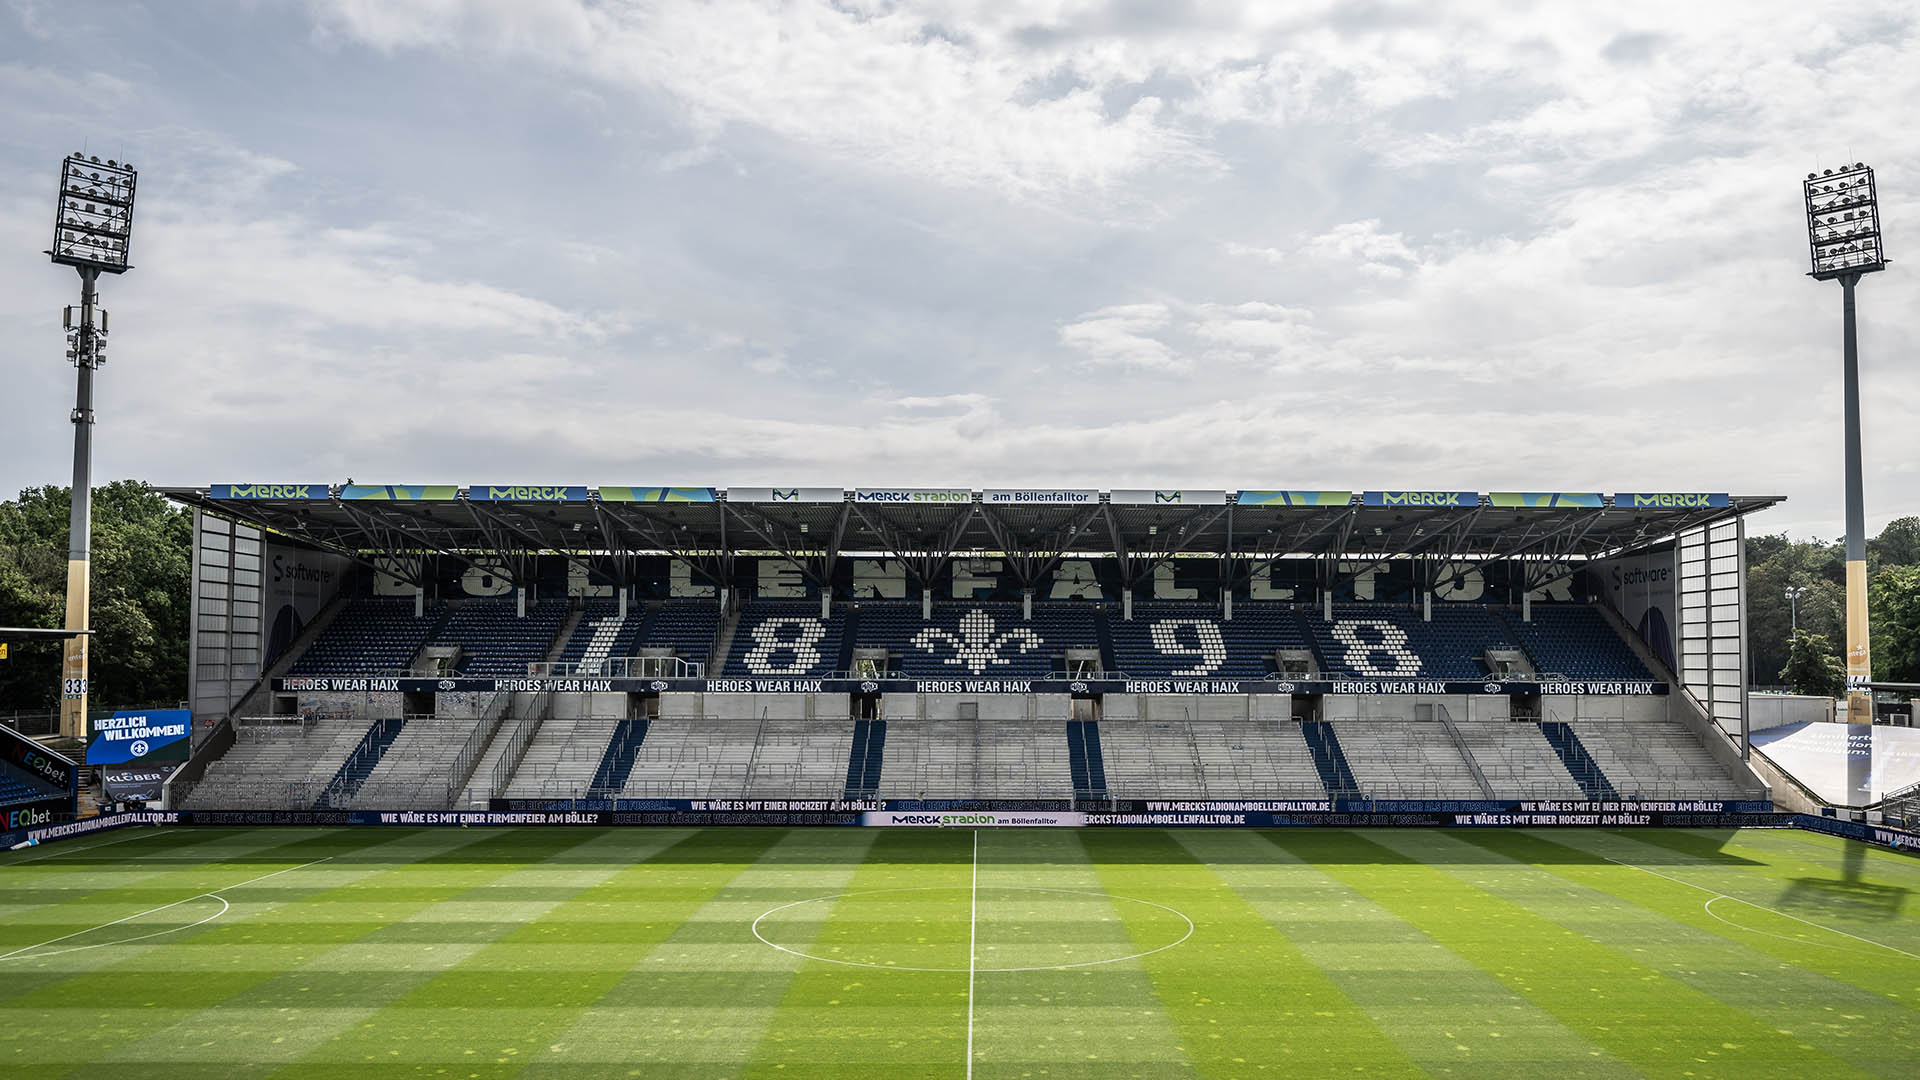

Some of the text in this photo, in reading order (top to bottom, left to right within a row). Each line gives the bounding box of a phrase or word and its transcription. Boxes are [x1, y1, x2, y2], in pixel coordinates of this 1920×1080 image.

[992, 492, 1089, 501] am Böllenfalltor
[743, 617, 826, 674] 8
[1151, 618, 1228, 676] 9
[1331, 619, 1423, 677] 8
[282, 679, 399, 690] HEROES WEAR HAIX
[583, 680, 612, 691] HAIX
[707, 680, 822, 692] HEROES WEAR HAIX
[916, 681, 1031, 692] HEROES WEAR HAIX
[1126, 682, 1240, 693] HEROES WEAR HAIX
[1332, 682, 1446, 693] HEROES WEAR HAIX
[1540, 683, 1653, 694] HEROES WEAR HAIX
[94, 716, 147, 731] HERZLICH
[104, 724, 185, 742] WILLKOMMEN!
[691, 801, 707, 810] WIE
[708, 799, 732, 810] WÄRE
[733, 801, 744, 810] ES
[745, 801, 761, 810] MIT
[763, 801, 788, 810] EINER
[790, 801, 828, 811] HOCHZEIT
[851, 799, 887, 811] BÖLLE?
[1146, 802, 1330, 811] WWW.MERCKSTADIONAMBOELLENFALLTOR.DE
[1520, 802, 1536, 811] WIE
[1538, 800, 1561, 811] WÄRE
[1562, 802, 1572, 811] ES
[1574, 802, 1590, 811] MIT
[1592, 802, 1620, 811] EINER
[1677, 802, 1692, 811] AM
[1693, 800, 1723, 811] BÖLLE?
[380, 811, 598, 824] WIE WÄRE ES MIT EINER FIRMENFEIER AM BÖLLE?
[1011, 816, 1058, 824] Böllenfalltor
[1455, 813, 1650, 825] WIE WÄRE ES MIT EINER HOCHZEIT AM BÖLLE?
